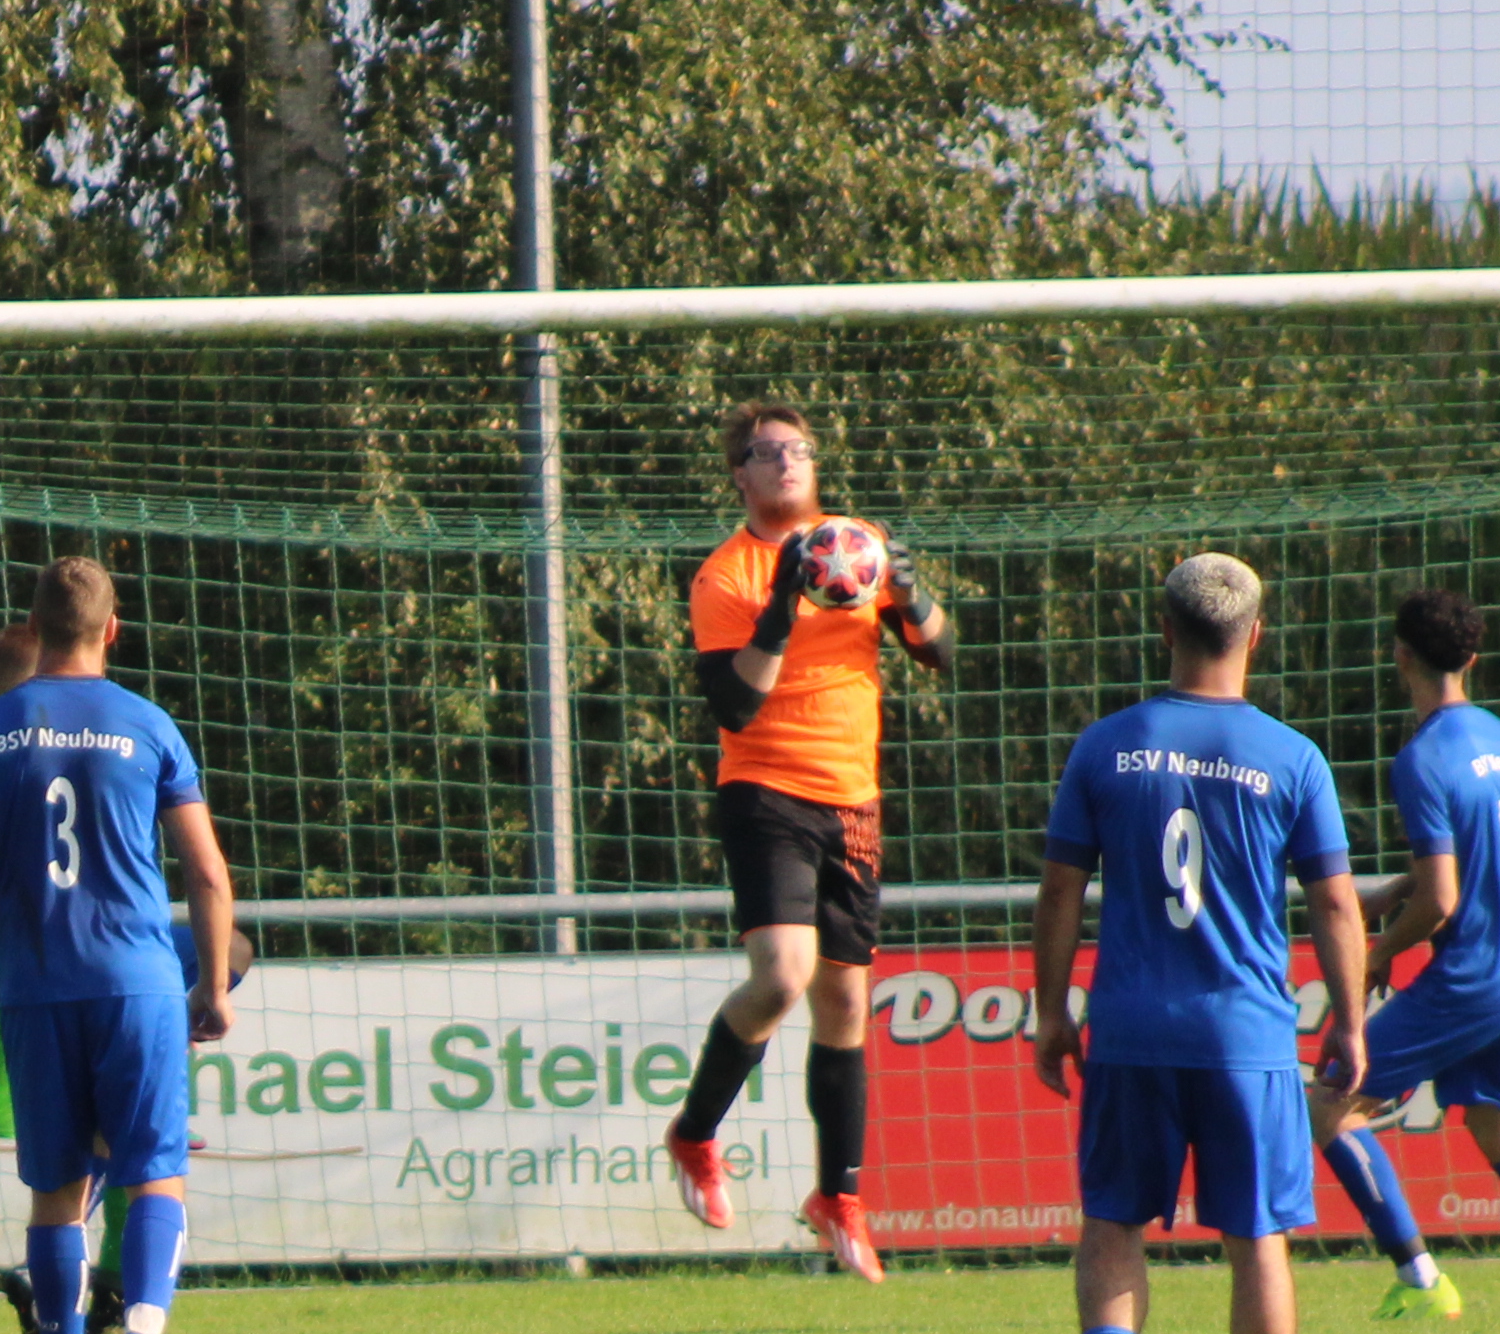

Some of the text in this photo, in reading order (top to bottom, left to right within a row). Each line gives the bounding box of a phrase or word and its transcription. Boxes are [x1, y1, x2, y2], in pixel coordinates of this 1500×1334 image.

[38, 727, 134, 757] Neuburg
[1116, 750, 1269, 795] BSV Neuburg
[45, 776, 80, 889] 3
[1162, 808, 1202, 929] 9
[188, 1027, 392, 1116] hael
[396, 1129, 769, 1201] Agrarhanel
